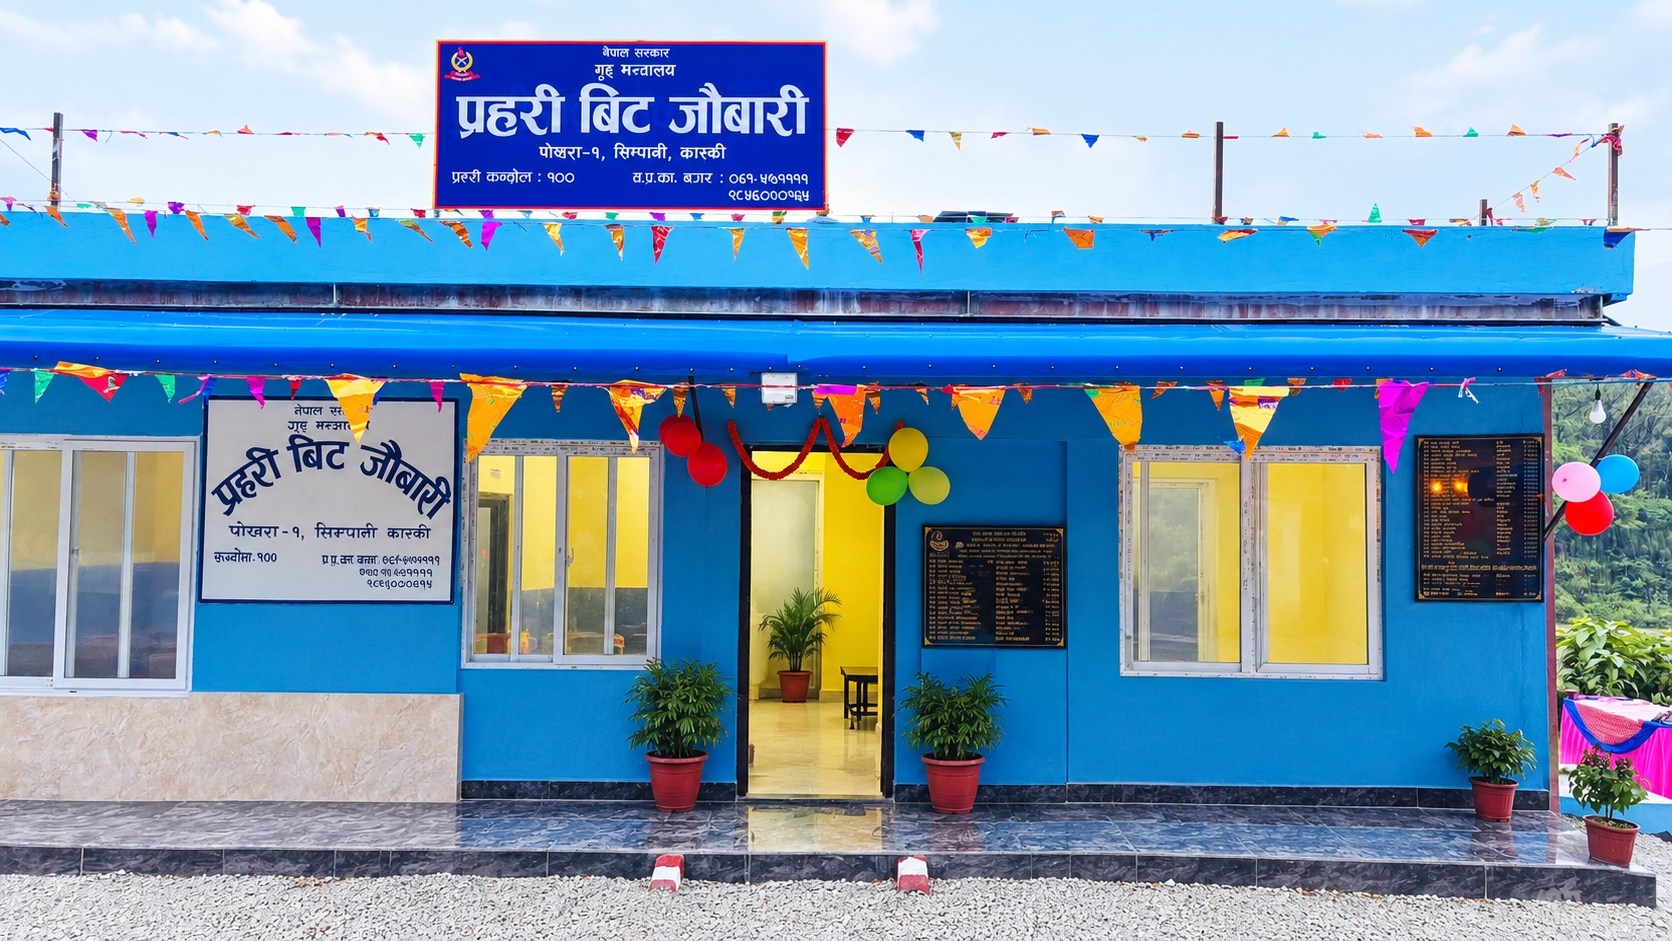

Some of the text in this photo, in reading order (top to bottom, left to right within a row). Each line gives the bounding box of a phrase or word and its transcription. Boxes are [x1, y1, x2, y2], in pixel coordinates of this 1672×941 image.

[456, 83, 809, 138] प्रहरी बिट जौबारी
[548, 172, 574, 183] १००
[211, 434, 451, 520] प्रहरी बिट जौबारी
